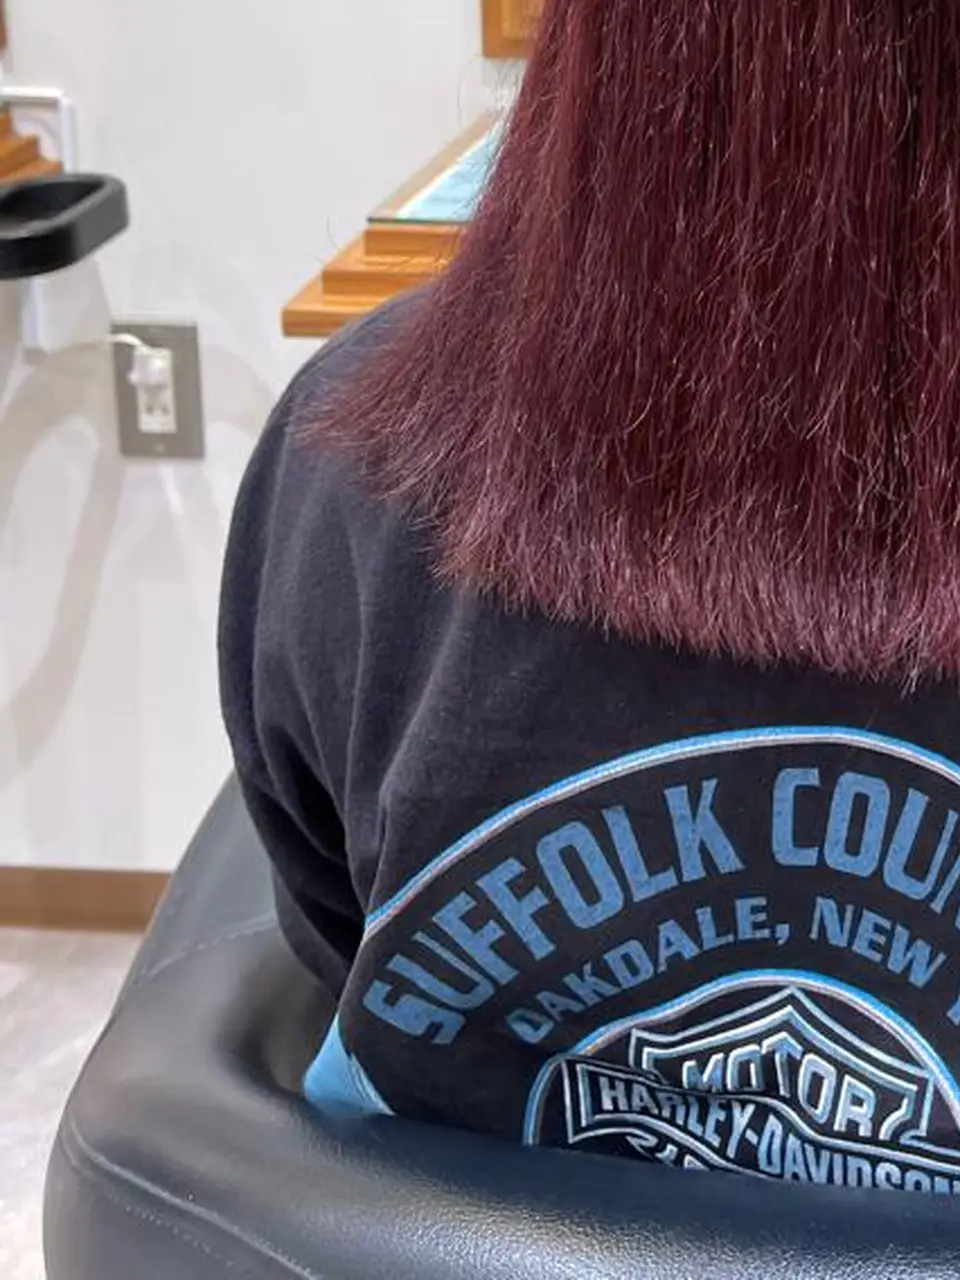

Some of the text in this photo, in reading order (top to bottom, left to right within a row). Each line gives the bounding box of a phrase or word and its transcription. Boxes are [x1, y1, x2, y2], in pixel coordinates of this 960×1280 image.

[362, 778, 746, 1046] SUFFOLK
[505, 895, 790, 1045] OAKDALE,
[810, 896, 947, 989] NEW
[683, 1031, 877, 1137] MOTOR
